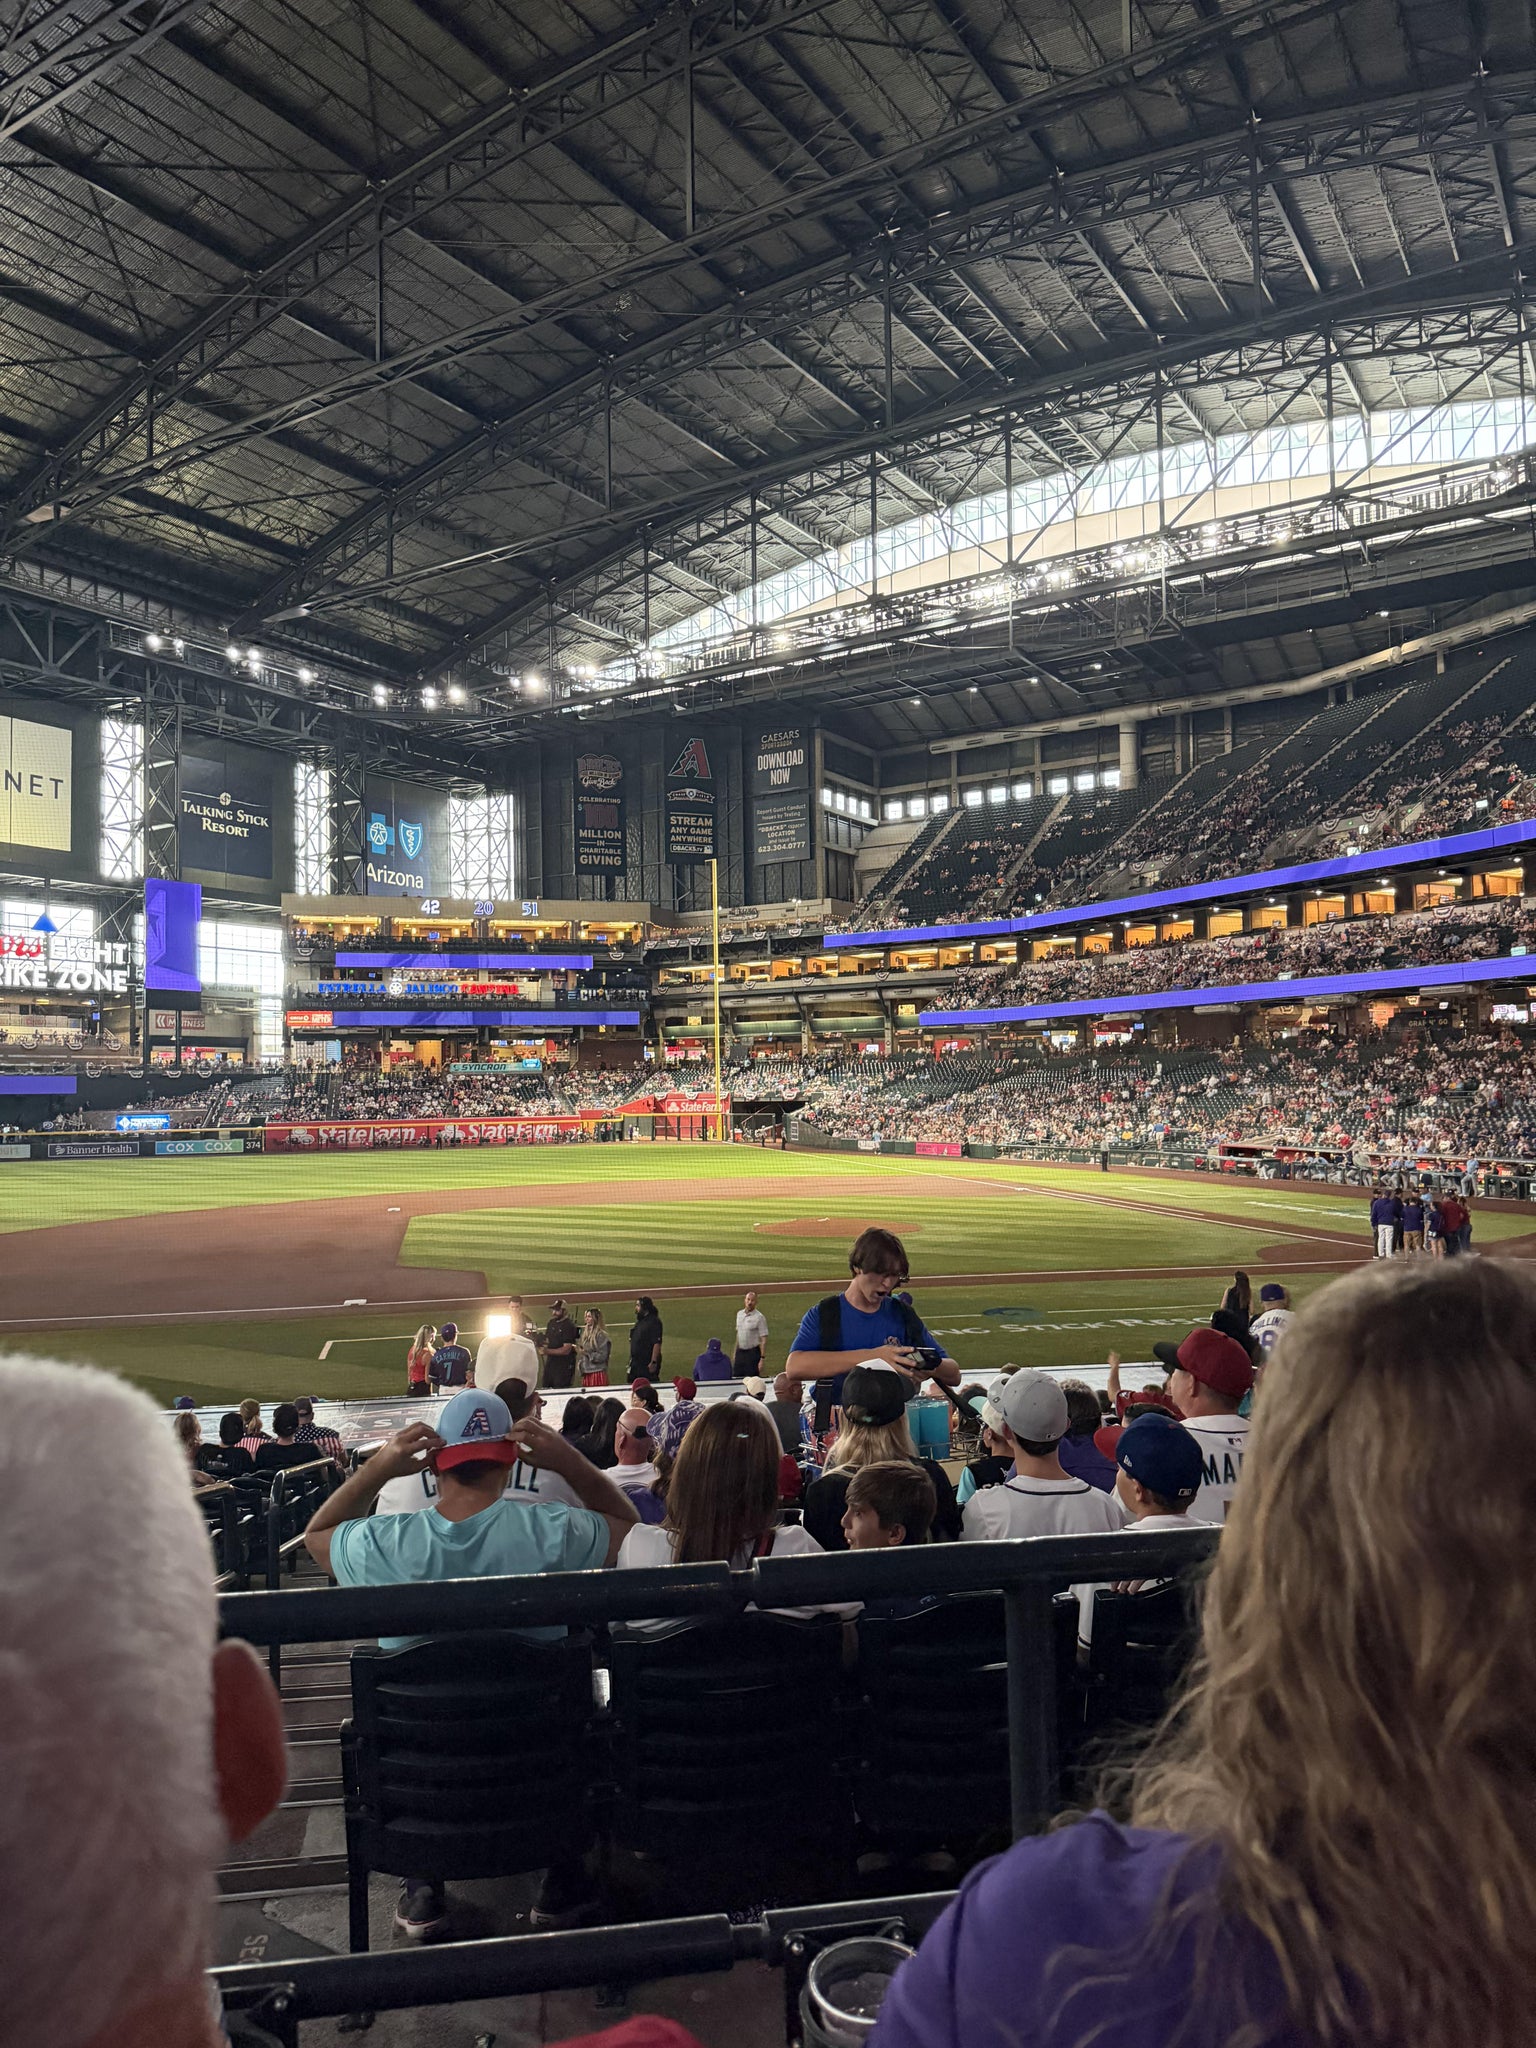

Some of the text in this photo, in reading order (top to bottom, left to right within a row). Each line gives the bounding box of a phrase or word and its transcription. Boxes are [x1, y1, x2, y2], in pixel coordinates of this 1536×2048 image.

[761, 730, 800, 743] CAESARS
[757, 749, 804, 771] DOWNLOAD
[770, 767, 791, 786] NOW
[578, 796, 622, 804] CELEBRATING
[181, 799, 269, 827] TALKING STICK
[670, 815, 713, 827] STREAM
[202, 817, 249, 838] RESORT
[670, 826, 713, 836] ANY GAME
[579, 829, 622, 840] MILLION
[670, 834, 713, 844] ANYWHERE
[767, 829, 796, 838] LOCATION
[579, 847, 622, 855] CHARITABLE
[757, 841, 807, 853] 623.304.0777
[579, 855, 622, 866] GIVING
[366, 862, 424, 890] Arizona
[420, 899, 539, 917] 42 20 51
[56, 968, 128, 992] ZONE
[461, 1063, 507, 1071] SYNCRON
[680, 1101, 702, 1112] State
[66, 1144, 132, 1155] Banner Health
[166, 1141, 233, 1153] COX COX
[246, 1141, 261, 1149] 374
[1000, 1322, 1117, 1333] STICK
[443, 1361, 453, 1380] 7
